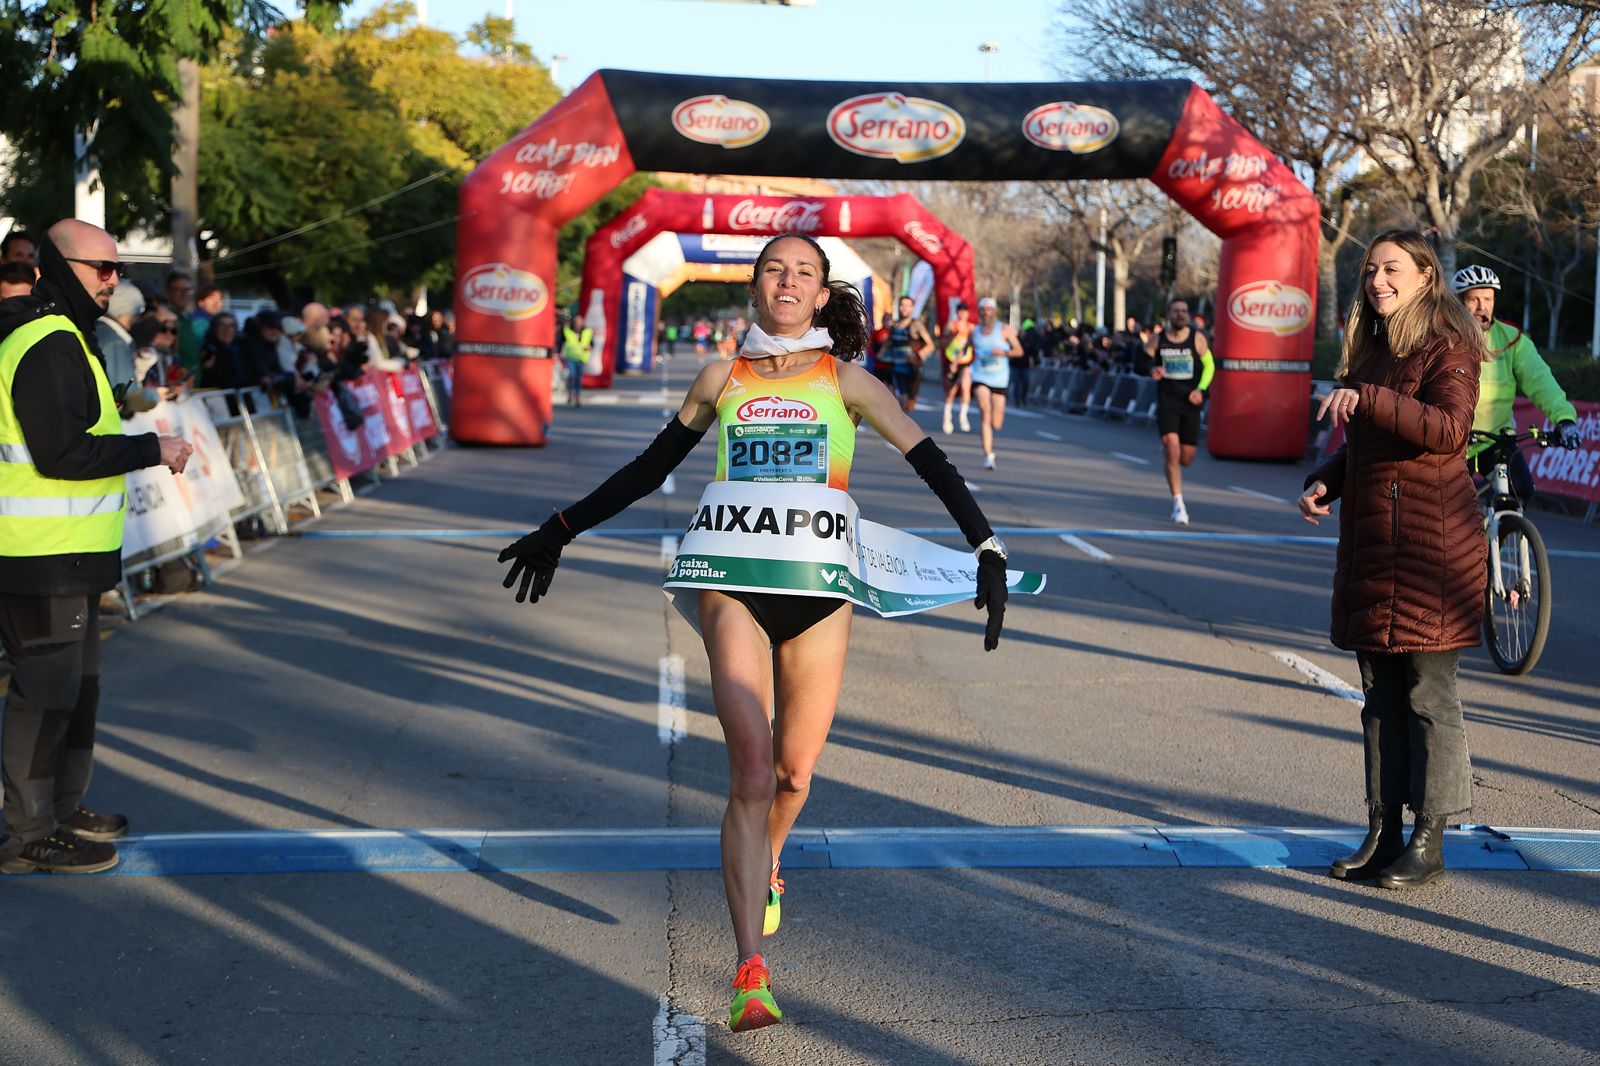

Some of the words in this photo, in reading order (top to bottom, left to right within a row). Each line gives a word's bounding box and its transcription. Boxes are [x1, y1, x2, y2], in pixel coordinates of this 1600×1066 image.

[684, 109, 760, 132] Serrano
[842, 109, 950, 142] Serrano
[1034, 117, 1109, 138] Serrano
[470, 277, 541, 303] Serrano
[1236, 298, 1310, 319] Serrano
[743, 404, 811, 419] Serrano
[731, 440, 813, 467] 2082
[679, 567, 727, 579] popular
[680, 558, 709, 569] caixa
